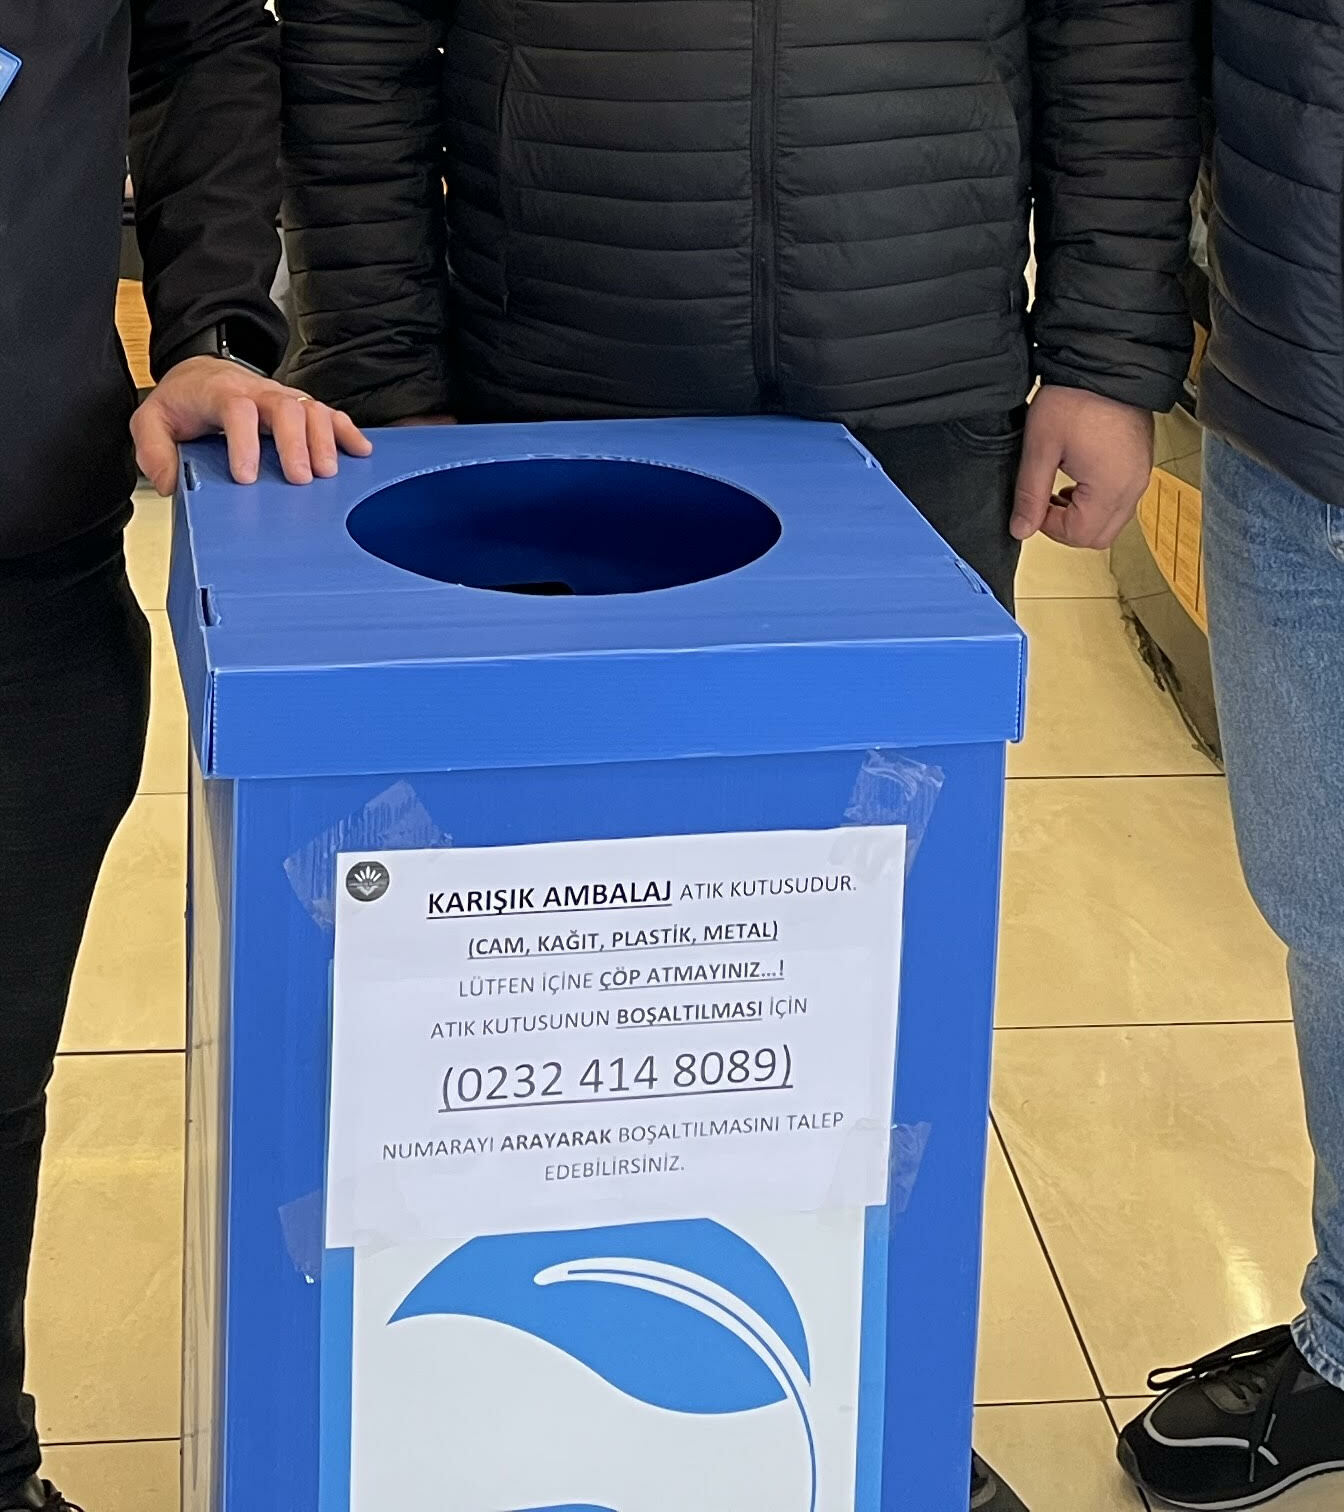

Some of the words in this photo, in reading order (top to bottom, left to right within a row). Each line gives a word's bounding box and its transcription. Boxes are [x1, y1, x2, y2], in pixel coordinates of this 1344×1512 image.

[427, 887, 534, 916] KARIŞIK
[542, 880, 673, 909] AMBALAJ
[679, 879, 723, 900] ATIK
[729, 875, 857, 899] KUTUSUDUR.
[467, 936, 531, 960] (CAM,
[537, 929, 605, 956] KAĞIT,
[611, 922, 697, 950] PLASTİK,
[703, 920, 779, 944] METAL)
[458, 973, 535, 999] LÜTFEN
[541, 970, 594, 996] İÇİNE
[598, 965, 641, 991] ÇÖP
[429, 1018, 476, 1040] ATIK
[481, 1010, 611, 1037] KUTUSUNUN
[616, 999, 763, 1028] BOŞALTILMASI
[767, 996, 808, 1021] İÇİN
[442, 1065, 564, 1112] (0232
[579, 1055, 659, 1094] 414
[672, 1043, 794, 1089] 8089)
[382, 1136, 494, 1161] NUMARAYI
[500, 1128, 612, 1154] ARAYARAK
[618, 1116, 781, 1145] BOŞALTILMASINI
[786, 1111, 845, 1130] TALEP
[544, 1154, 687, 1182] EDEBİLİRSİNİZ.
